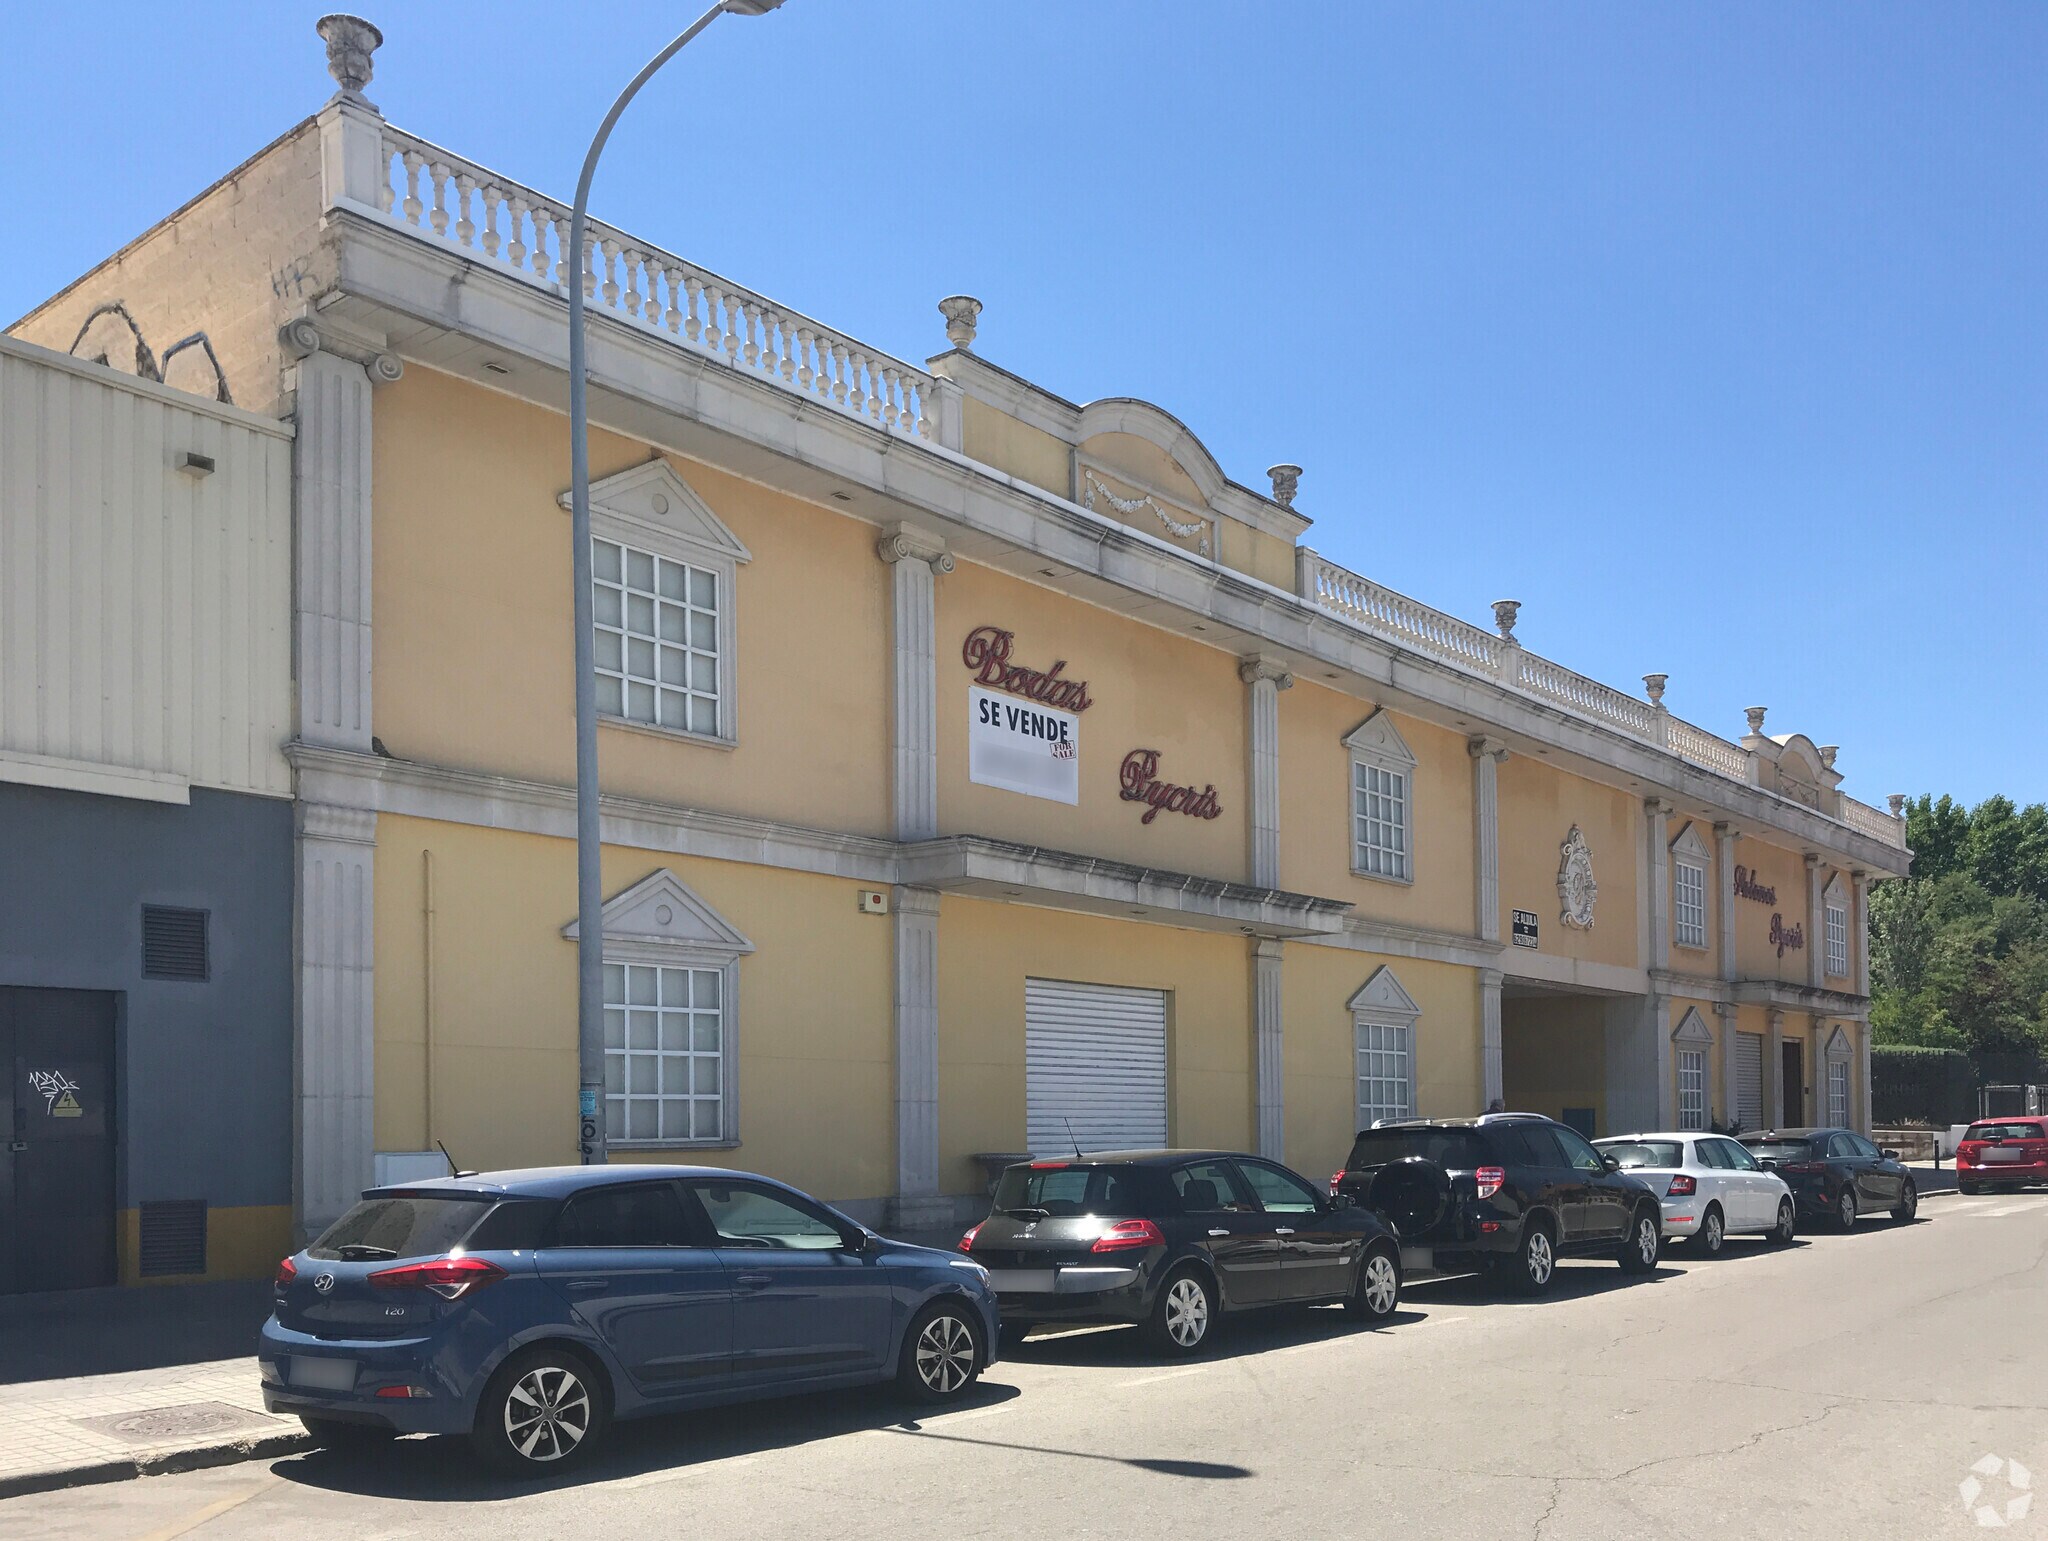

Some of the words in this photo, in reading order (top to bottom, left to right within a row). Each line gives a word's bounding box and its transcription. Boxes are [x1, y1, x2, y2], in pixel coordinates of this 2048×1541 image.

[962, 626, 1094, 712] Bodas
[979, 698, 1001, 727] SE
[1005, 705, 1068, 744] VENDE
[1052, 749, 1074, 759] SALE
[1053, 741, 1072, 752] FOR
